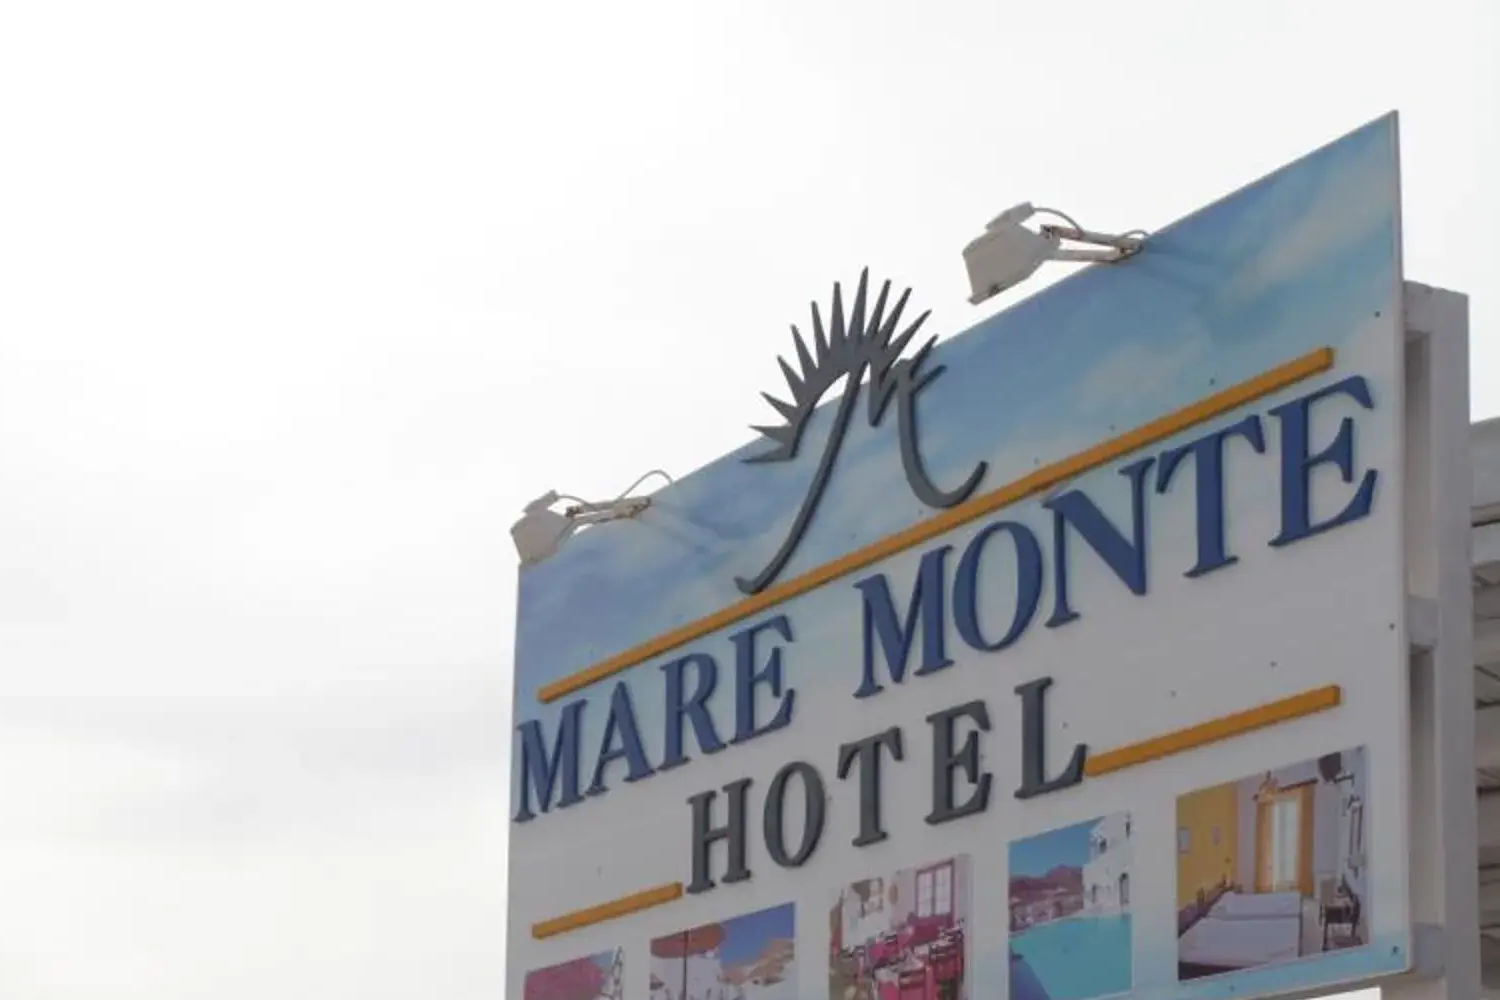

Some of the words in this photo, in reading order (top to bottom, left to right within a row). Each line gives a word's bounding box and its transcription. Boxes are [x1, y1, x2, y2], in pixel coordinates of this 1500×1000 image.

[513, 615, 794, 823] MARE
[853, 375, 1378, 699] MONTE
[685, 677, 1088, 893] HOTEL
